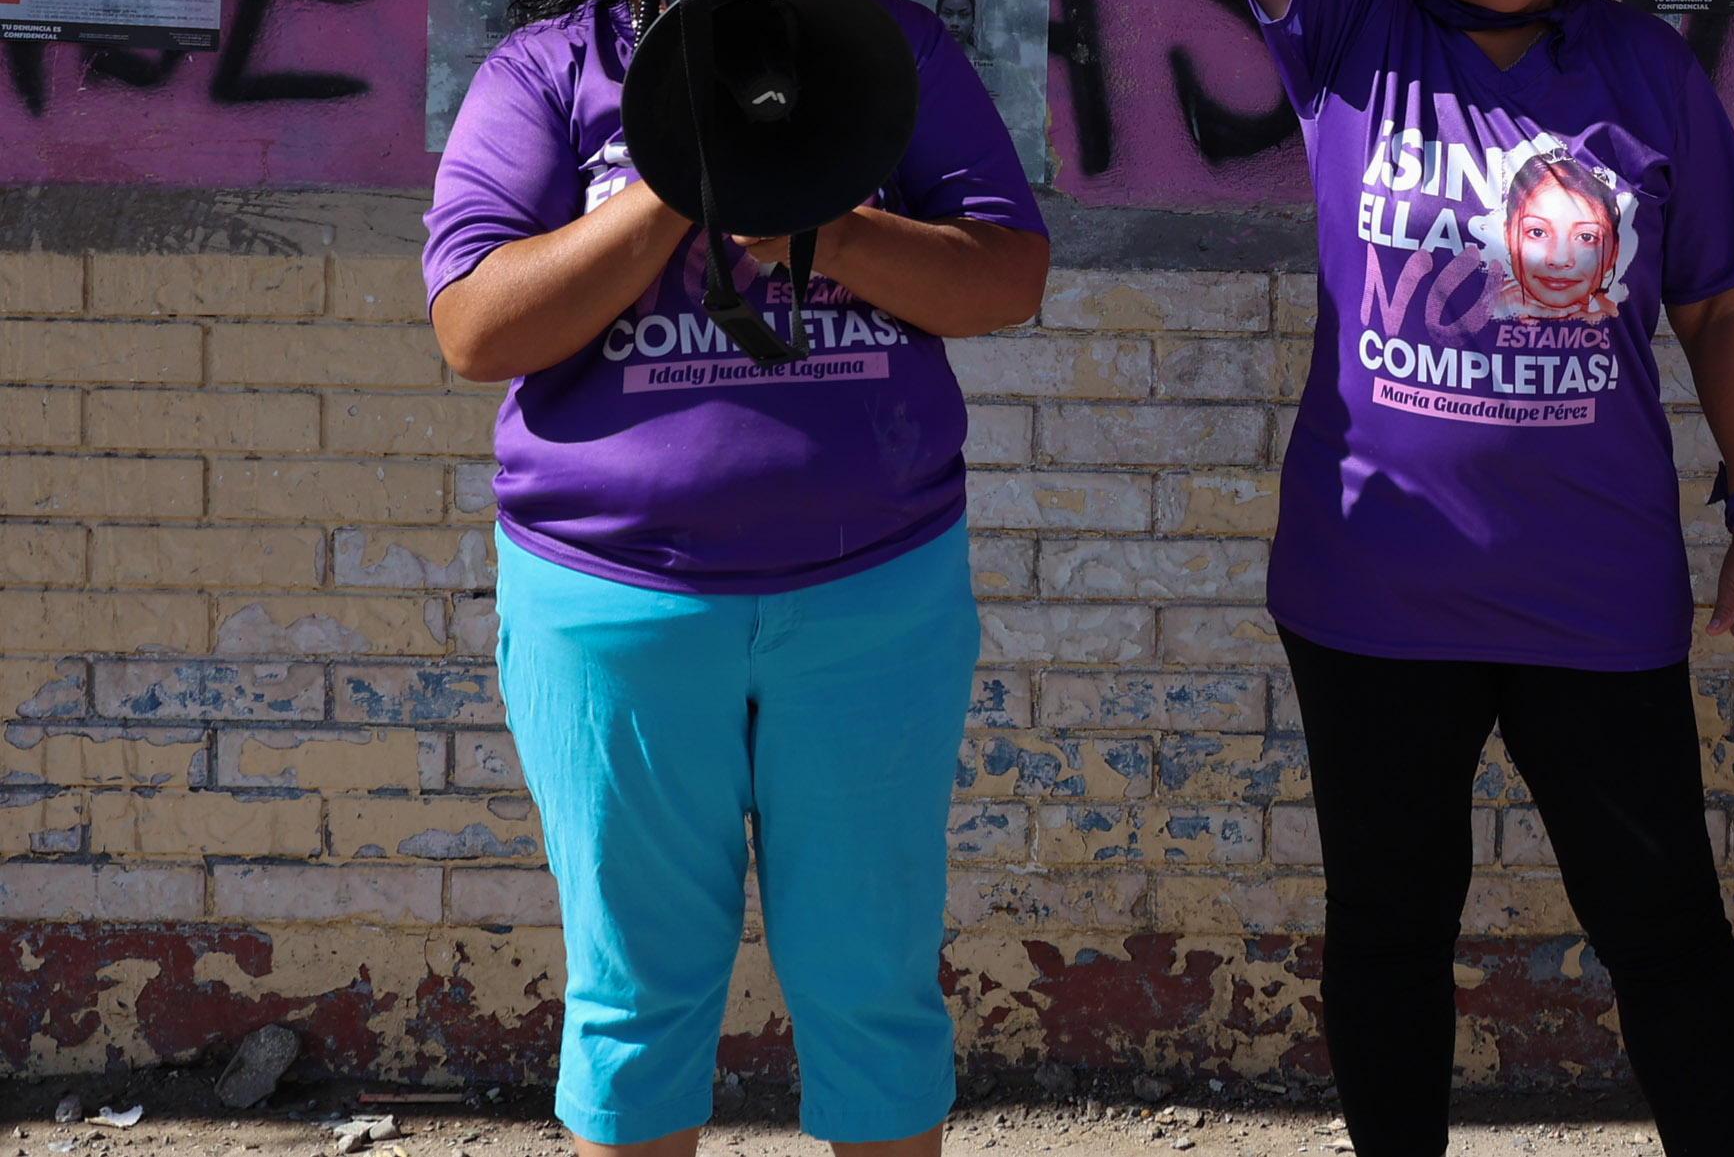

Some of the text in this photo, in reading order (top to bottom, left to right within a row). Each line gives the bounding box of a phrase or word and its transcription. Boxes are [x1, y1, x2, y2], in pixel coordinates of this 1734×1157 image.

[3, 32, 58, 40] CONFIDENCIAL
[13, 24, 52, 32] DENUNCIA
[1362, 119, 1503, 211] ¡SIN
[1358, 191, 1500, 258] ELLAS
[1360, 243, 1505, 346] NO
[1496, 325, 1610, 350] ESTAMOS
[649, 363, 704, 386] Idaly
[789, 358, 865, 378] Laguna
[1359, 329, 1619, 396] COMPLETAS!
[1380, 384, 1588, 422] María Guadalupe Pérez
